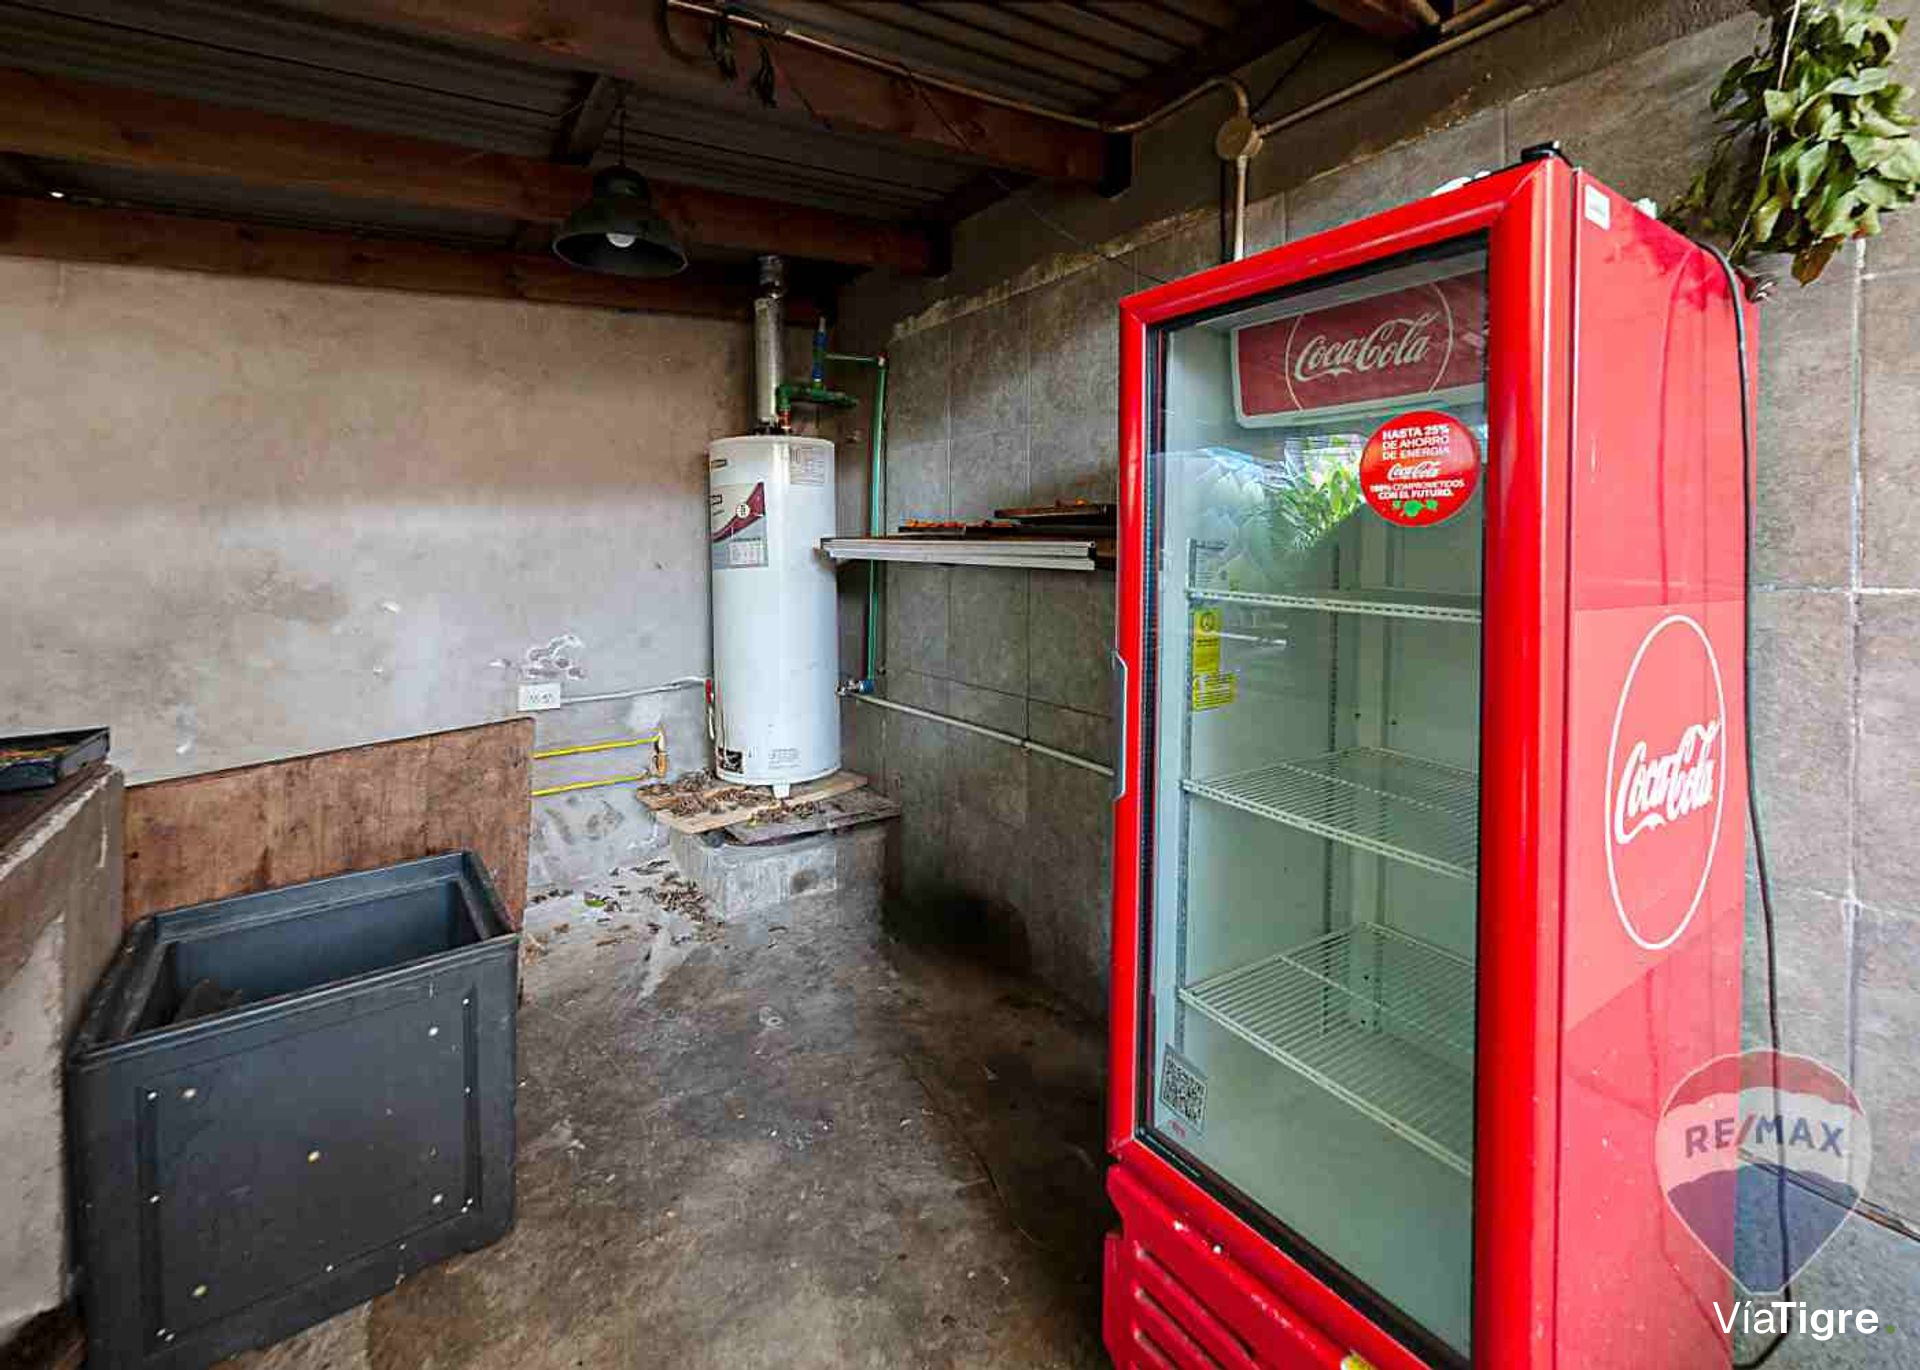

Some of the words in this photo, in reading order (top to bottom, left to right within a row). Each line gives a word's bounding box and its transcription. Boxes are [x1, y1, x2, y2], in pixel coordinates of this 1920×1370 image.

[1383, 427, 1422, 440] HASTA
[1383, 441, 1397, 450] DE
[1400, 436, 1449, 448] AHORRO
[1383, 452, 1397, 460] DE
[1379, 491, 1396, 500] CON
[1398, 491, 1408, 499] EL
